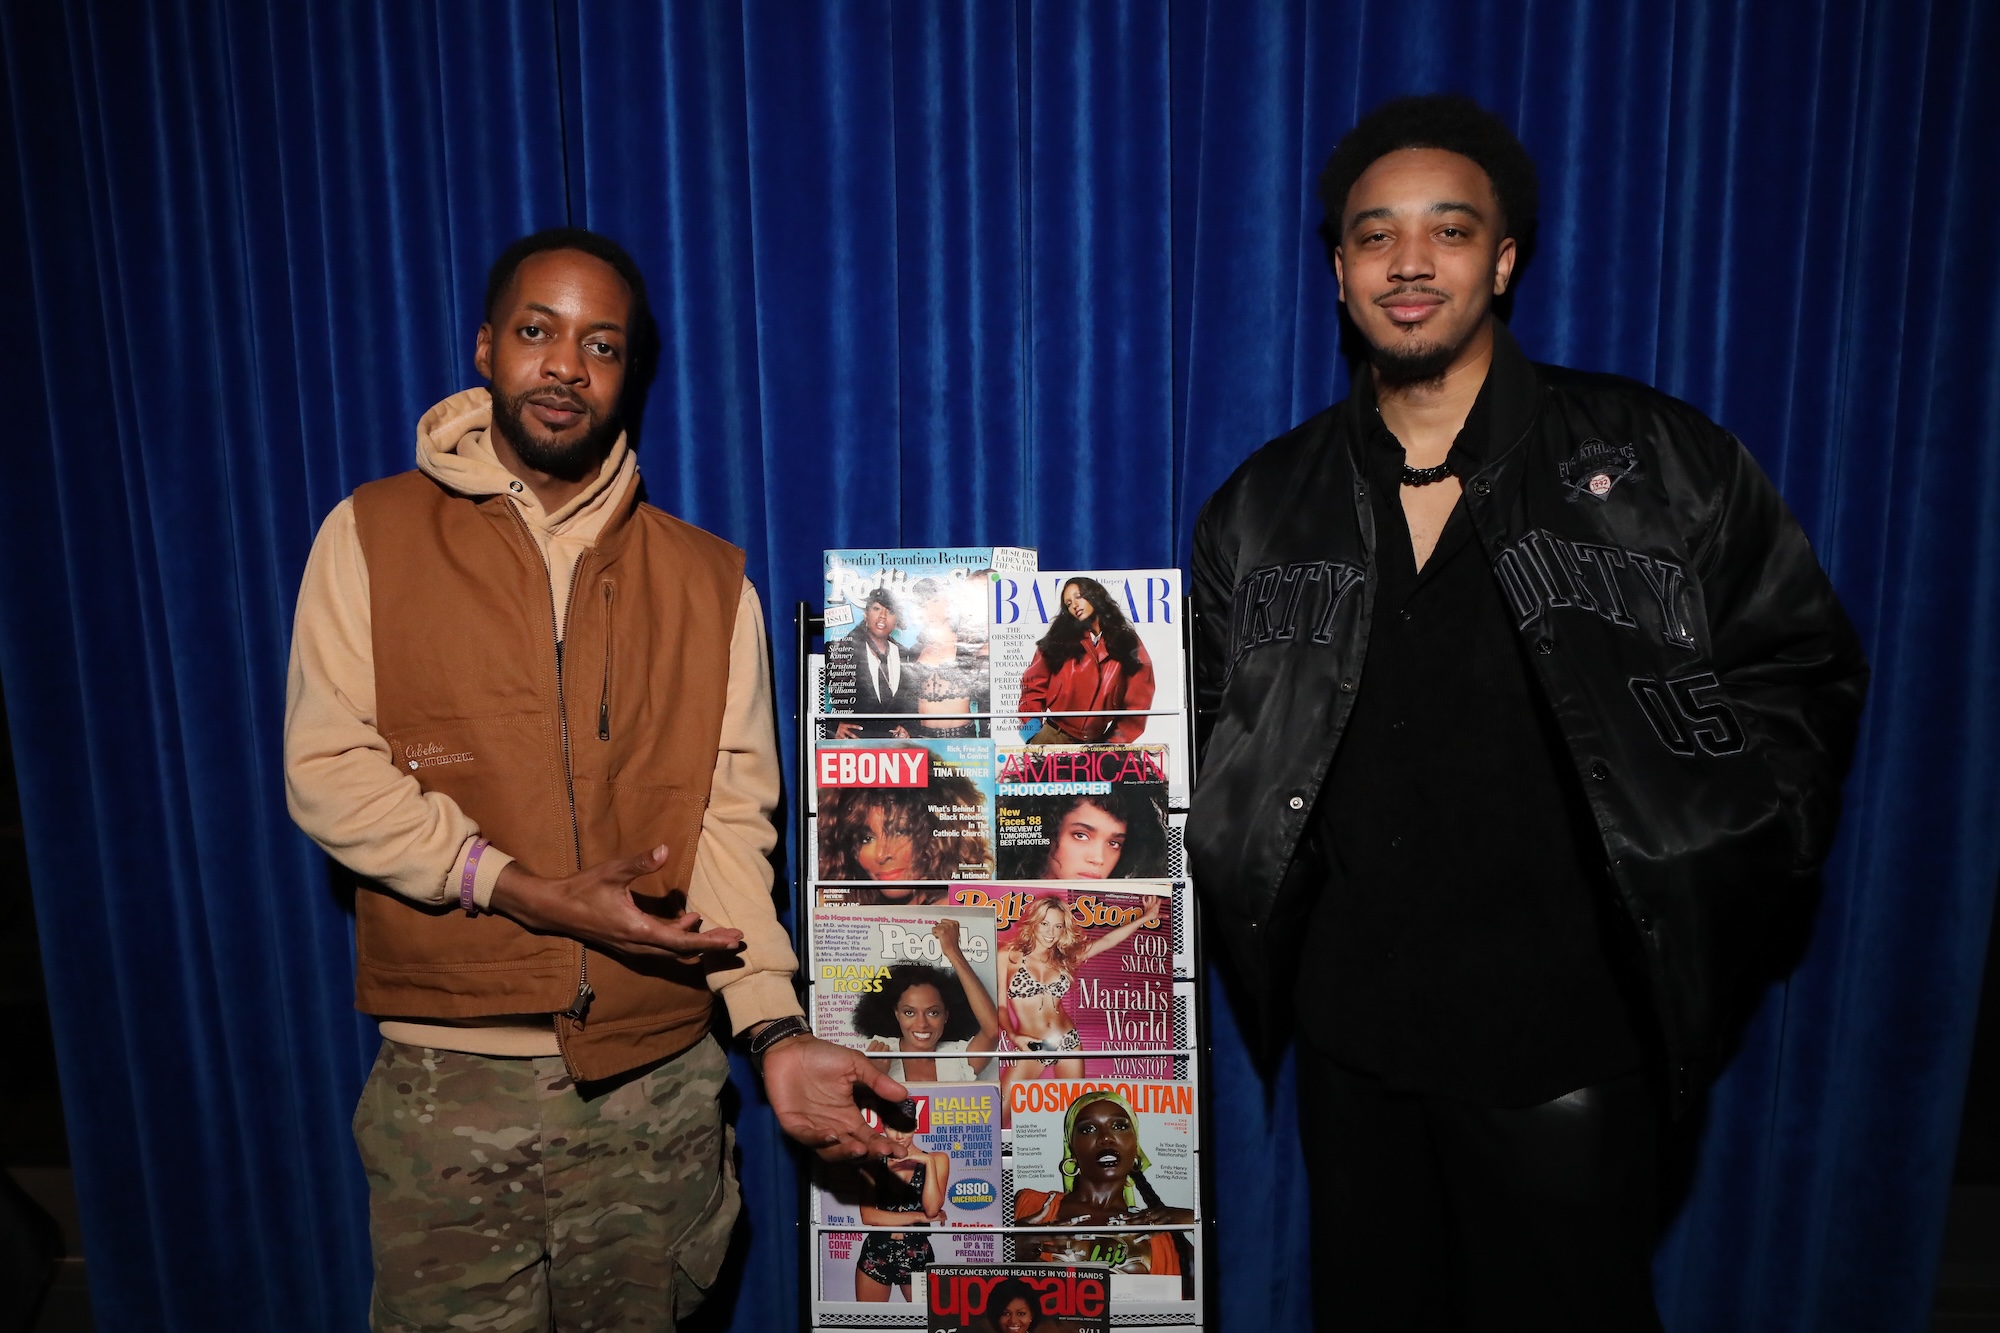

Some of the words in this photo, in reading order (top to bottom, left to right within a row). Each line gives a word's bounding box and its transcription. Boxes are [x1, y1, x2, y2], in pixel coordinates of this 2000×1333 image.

[878, 552, 936, 565] Tarantino
[939, 551, 988, 565] Returns
[996, 555, 1019, 563] LADEN
[1021, 558, 1036, 566] AND
[992, 577, 1175, 624] BAAR
[827, 614, 850, 624] ISSUE
[828, 644, 854, 652] Sleater-
[829, 652, 853, 660] Kinney
[826, 661, 857, 669] Christina
[826, 669, 856, 678] Aguilera
[828, 686, 857, 694] Williams
[1628, 672, 1746, 758] 05
[821, 753, 924, 784] EBONY
[999, 752, 1164, 783] AMERICAN
[933, 767, 953, 777] TINA
[955, 767, 989, 778] TURNER
[999, 783, 1110, 797] PHOTOGRAPHER
[977, 805, 989, 813] The
[1000, 808, 1020, 816] New
[959, 813, 989, 821] Rebellion
[1000, 817, 1025, 825] Faces
[1027, 816, 1041, 825] '88
[961, 830, 989, 838] Church?
[1017, 838, 1050, 846] SHOOTERS
[962, 872, 989, 880] Intimate
[831, 914, 851, 922] Hope
[879, 924, 989, 967] Peole
[1134, 934, 1167, 957] GOD
[1121, 955, 1167, 974] SMACK
[822, 965, 892, 979] DIANA
[833, 979, 884, 992] ROSS
[1078, 978, 1168, 1011] Mariah's
[1104, 1010, 1168, 1042] World
[1113, 1057, 1167, 1075] NONSTOP
[935, 1096, 991, 1111] HALLE
[931, 1110, 992, 1125] BERRY
[937, 1126, 947, 1134] ON
[966, 1125, 992, 1133] PUBLIC
[921, 1134, 960, 1142] TROUBLES,
[962, 1133, 992, 1141] PRIVATE
[931, 1143, 951, 1151] JOYS
[954, 1142, 960, 1150] &
[963, 1142, 992, 1150] SUDDEN
[979, 1150, 992, 1158] FOR
[973, 1158, 992, 1166] BABY
[955, 1182, 989, 1195] SISQO
[952, 1195, 993, 1203] UNCENSORED
[828, 1215, 844, 1223] How
[828, 1233, 863, 1241] DREAMS
[828, 1241, 852, 1250] COME
[829, 1250, 850, 1260] TRUE
[1078, 1272, 1104, 1280] HANDS
